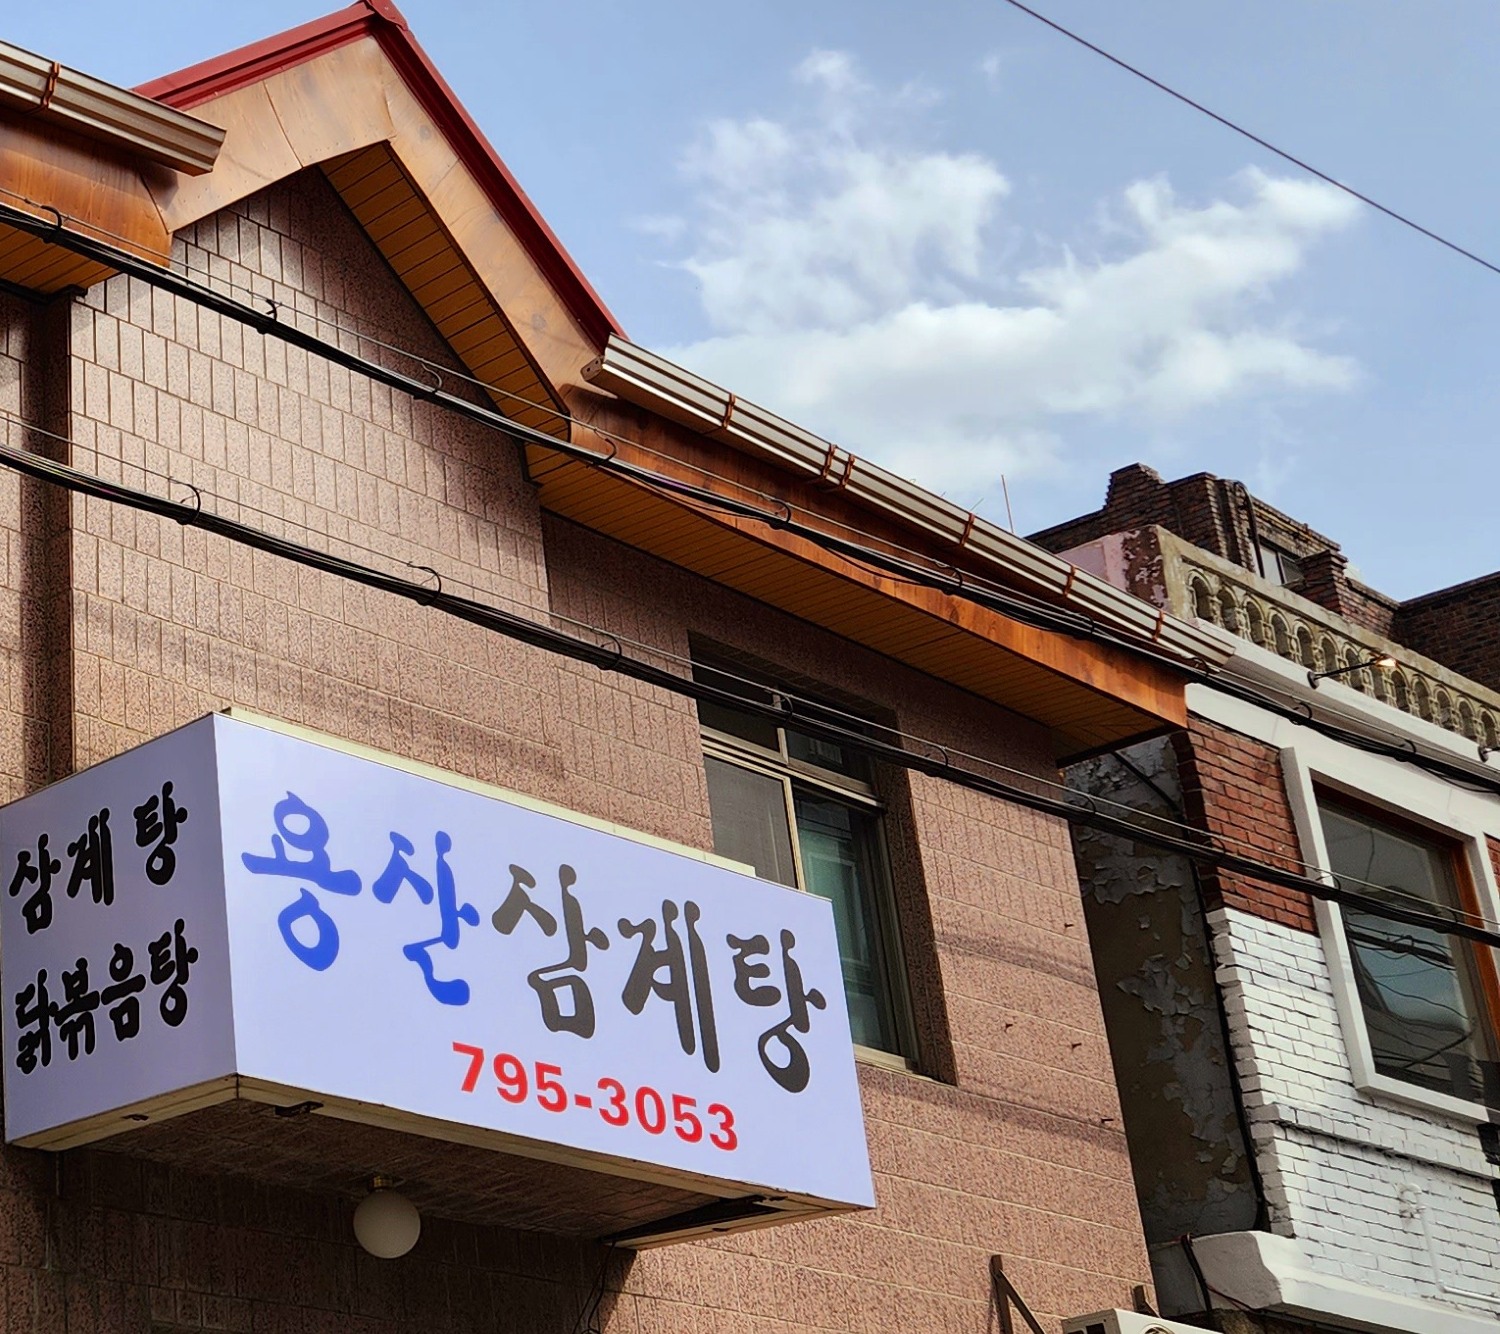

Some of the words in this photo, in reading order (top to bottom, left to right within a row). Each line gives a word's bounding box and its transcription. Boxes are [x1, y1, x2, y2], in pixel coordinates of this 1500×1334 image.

[9, 781, 188, 935] 삼계탕
[15, 918, 199, 1075] 닭볶음탕
[452, 1042, 739, 1151] 795-3053
